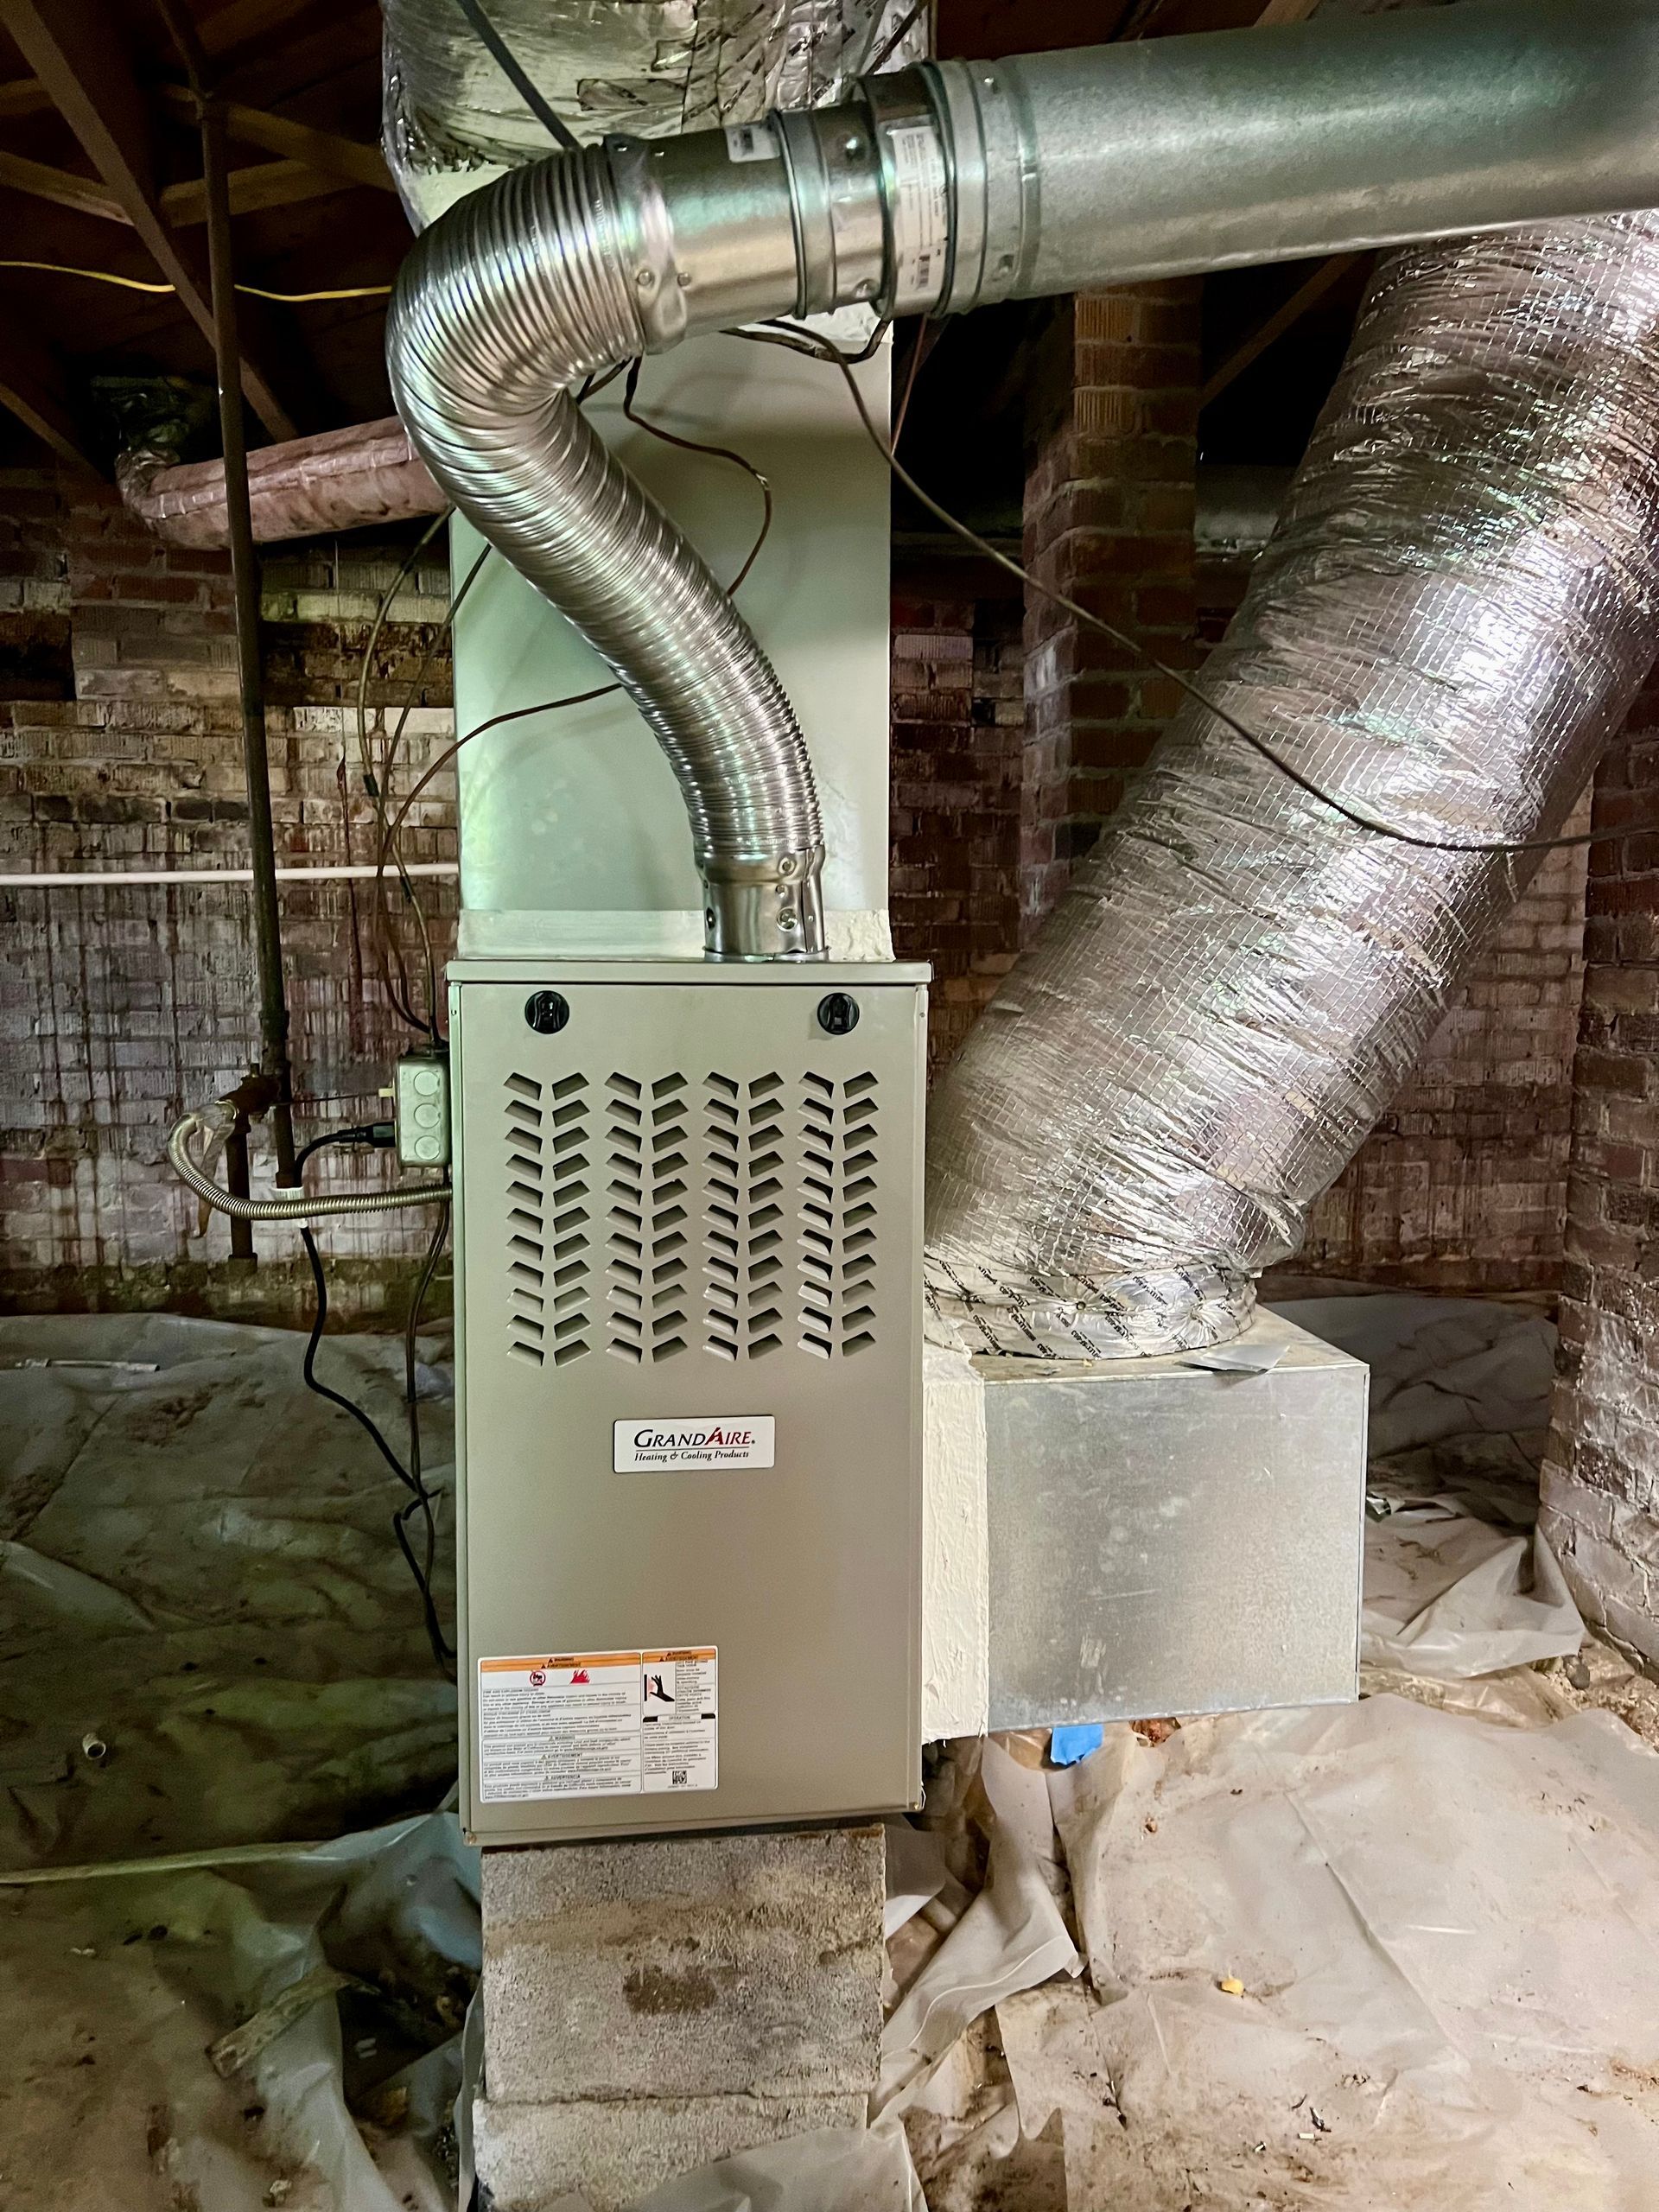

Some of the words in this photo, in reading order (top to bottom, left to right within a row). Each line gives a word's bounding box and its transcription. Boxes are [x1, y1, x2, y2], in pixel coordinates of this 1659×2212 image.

[634, 1452, 668, 1462] Heating
[681, 1451, 713, 1461] Cooling
[715, 1450, 749, 1459] Products
